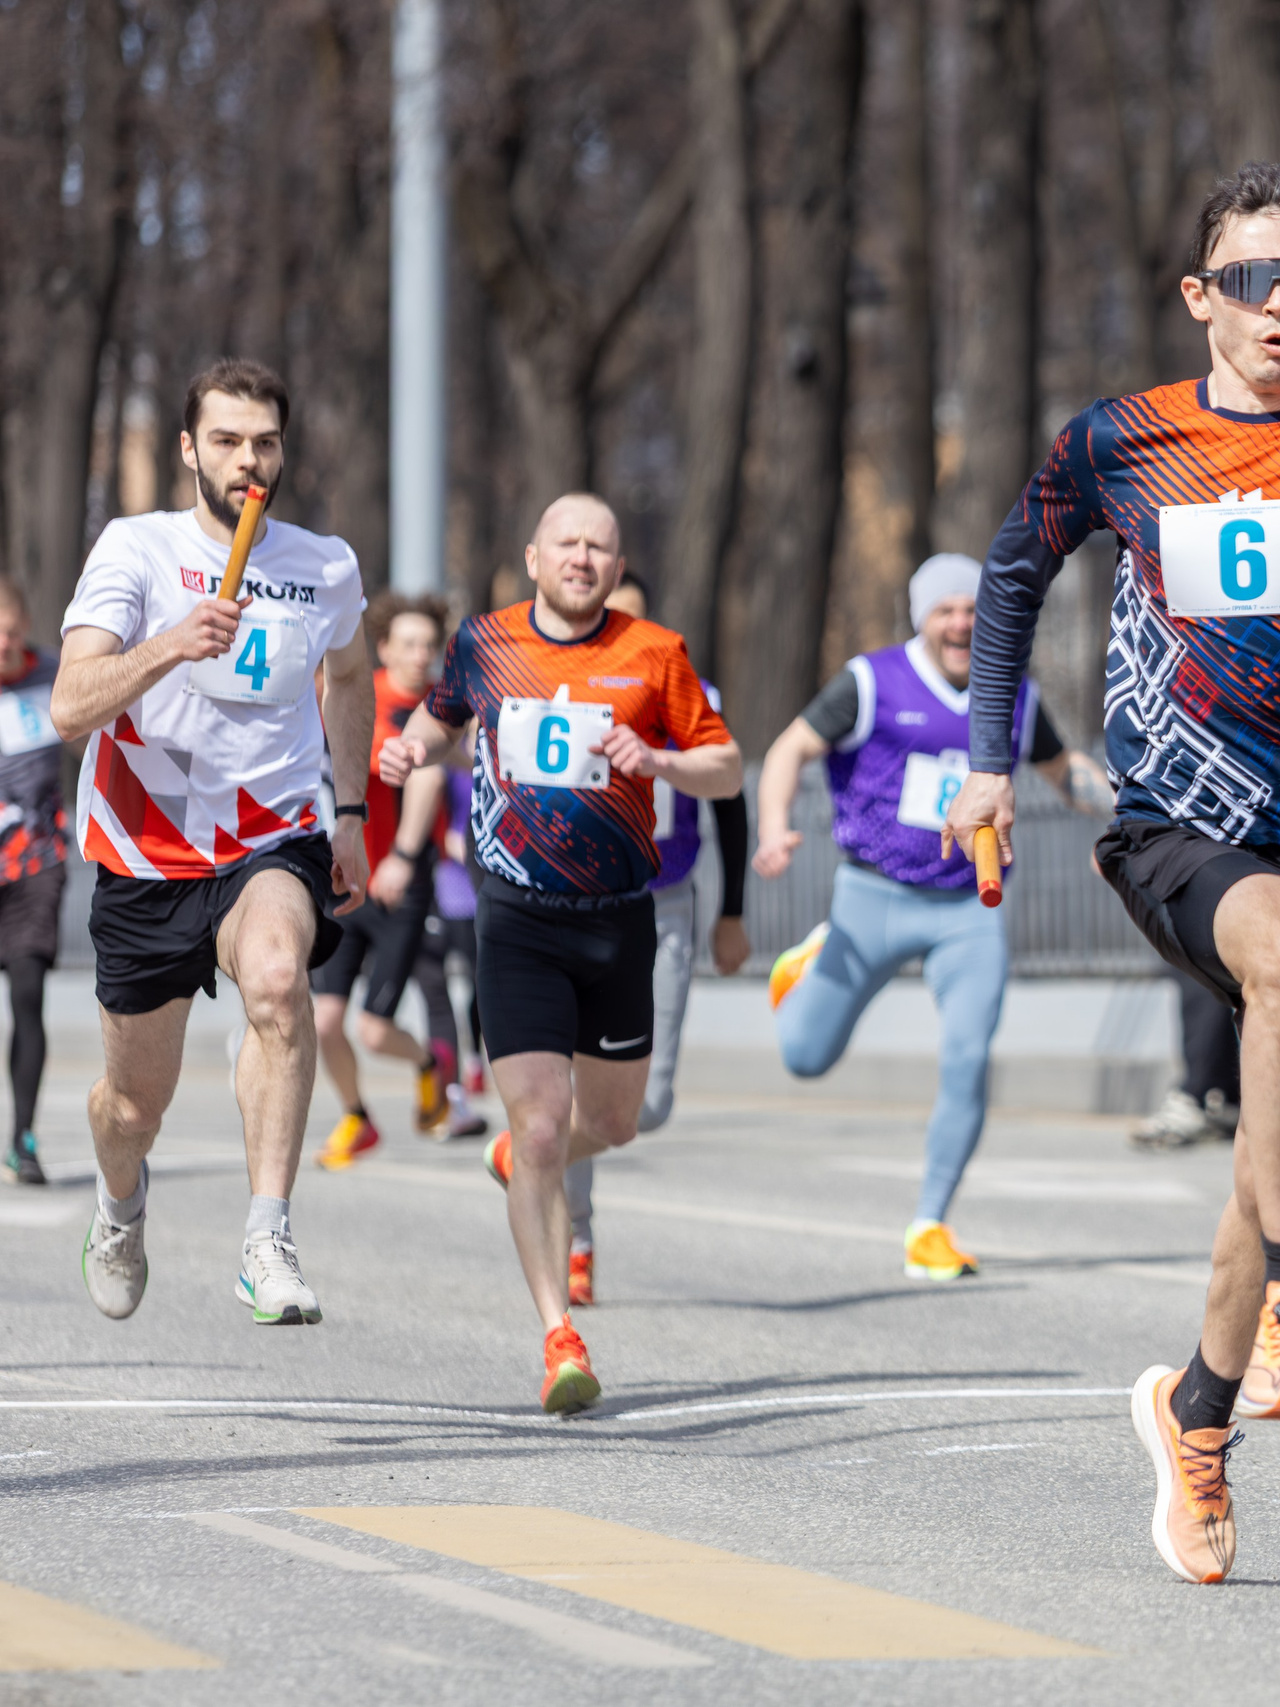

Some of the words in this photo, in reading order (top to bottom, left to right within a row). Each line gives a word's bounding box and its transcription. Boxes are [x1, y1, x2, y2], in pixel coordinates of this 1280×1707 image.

[207, 575, 316, 604] ЛКОЙЛ
[1219, 518, 1267, 601] 6
[234, 628, 271, 691] 4
[536, 715, 571, 774] 6
